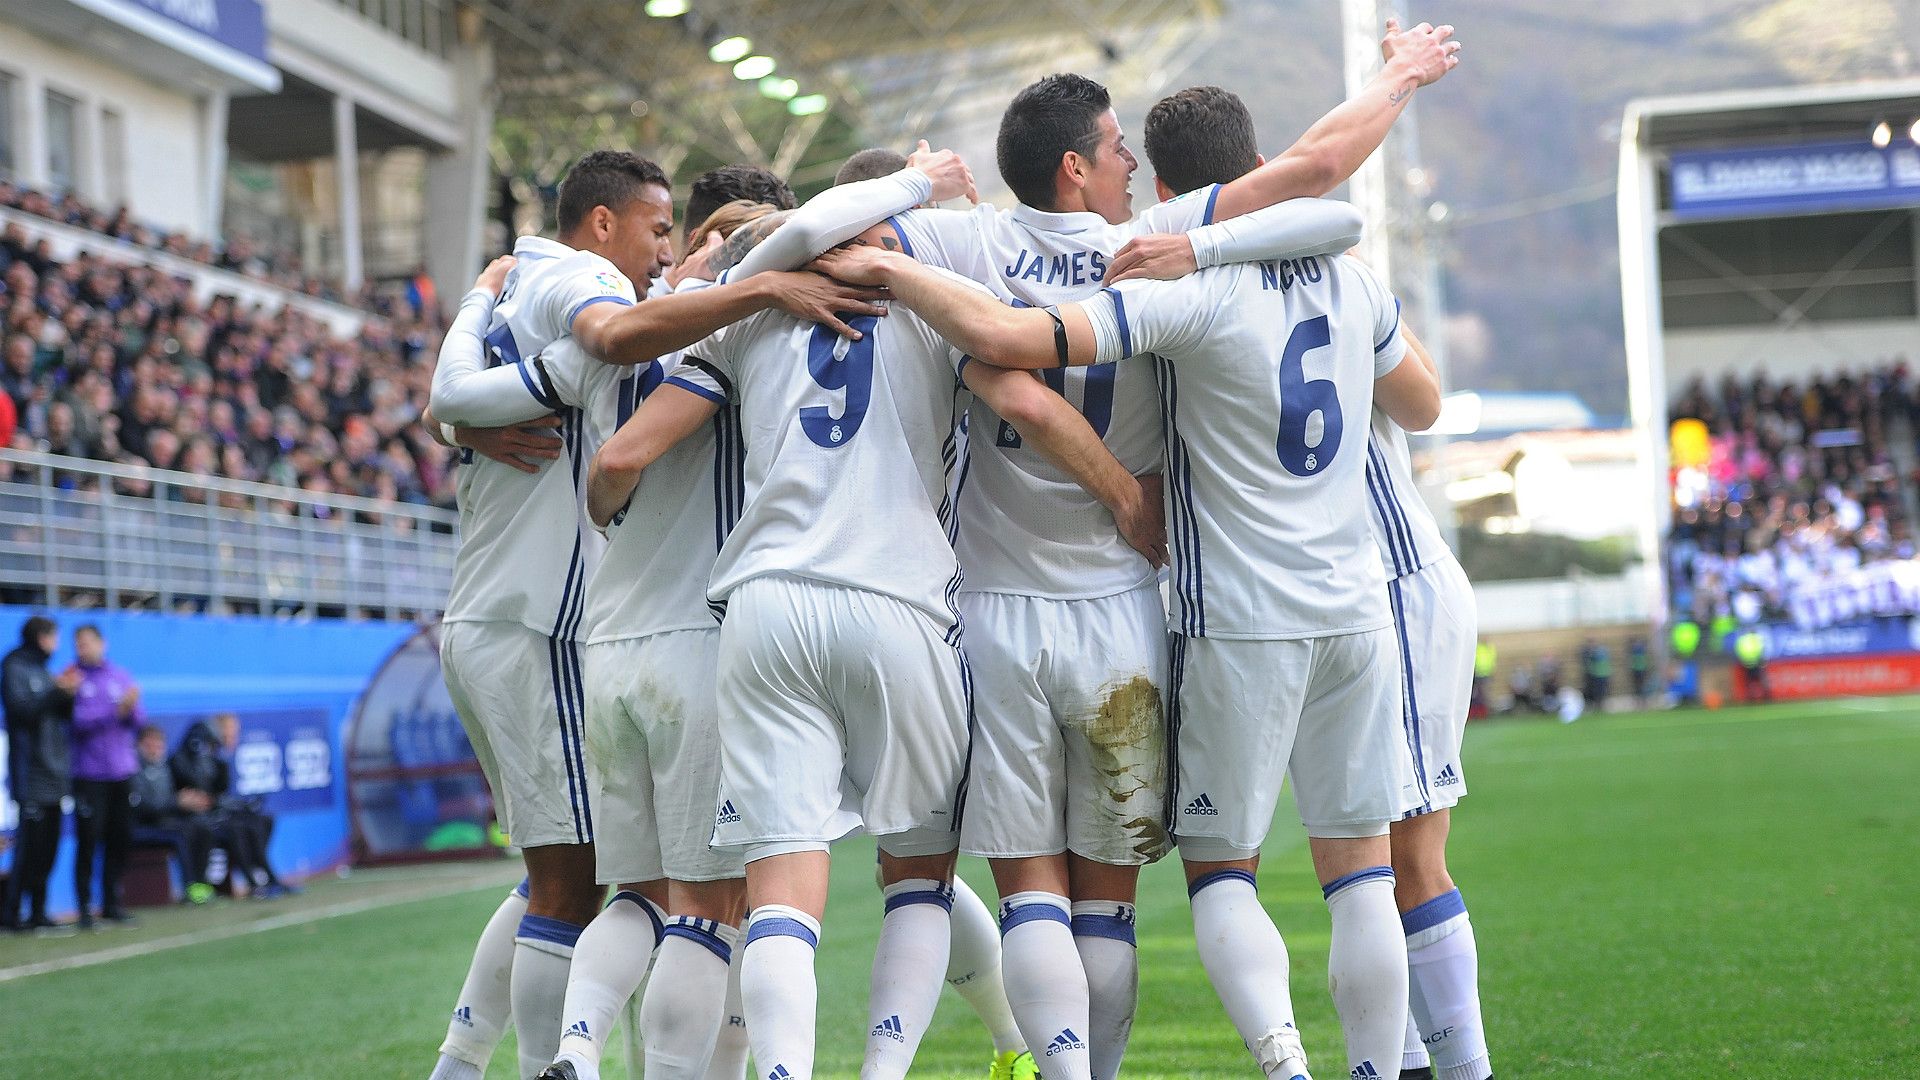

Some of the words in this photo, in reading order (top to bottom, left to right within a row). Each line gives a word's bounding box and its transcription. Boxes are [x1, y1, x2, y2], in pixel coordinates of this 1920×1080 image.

[1006, 249, 1107, 287] JAMES
[800, 309, 879, 448] 9
[1276, 314, 1343, 477] 6
[1184, 806, 1219, 816] adidas
[871, 1028, 905, 1043] adidas
[1046, 1042, 1086, 1057] adidas
